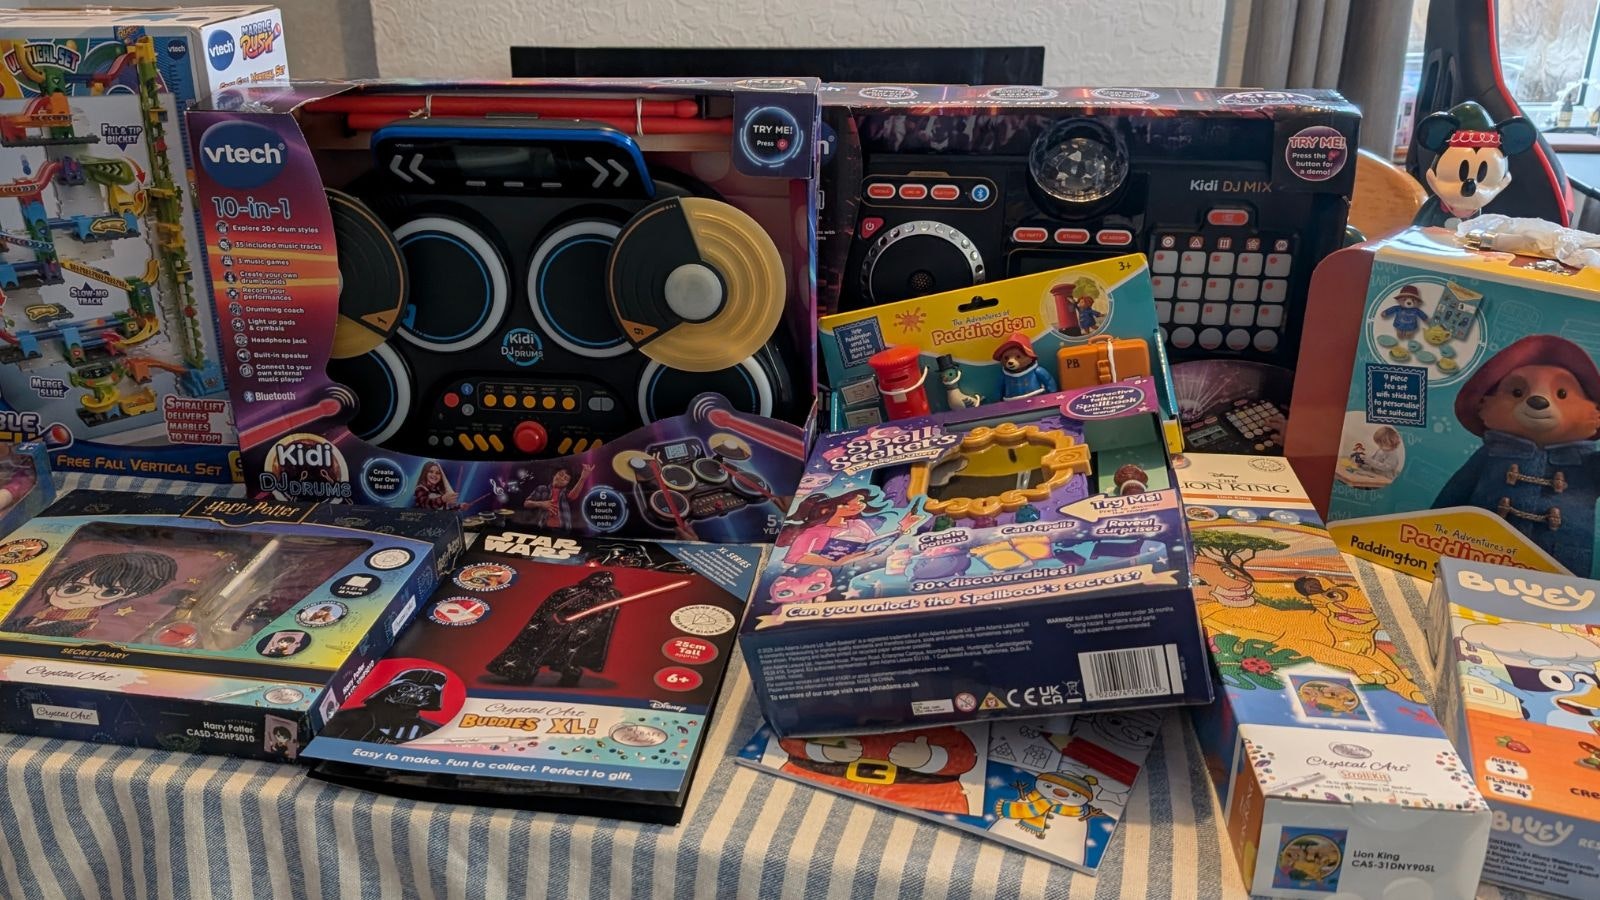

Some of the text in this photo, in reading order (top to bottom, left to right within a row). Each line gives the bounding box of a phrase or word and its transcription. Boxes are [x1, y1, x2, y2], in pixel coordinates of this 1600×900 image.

[241, 19, 272, 36] MARBLE
[209, 40, 235, 57] vtech
[240, 32, 273, 60] RUSH
[753, 125, 793, 134] TRY ME!
[107, 135, 138, 144] BUCKET
[1288, 136, 1346, 149] TRY ME!
[204, 143, 282, 164] vtech
[1295, 160, 1321, 168] button
[1190, 179, 1272, 193] Kidi DJ MIX
[211, 196, 291, 219] 10-in-1
[232, 224, 260, 232] Explore
[277, 225, 297, 233] drum
[298, 226, 319, 234] styles
[1118, 261, 1132, 271] 3+
[70, 288, 108, 298] SLOW-MO
[243, 294, 292, 302] performances
[78, 297, 103, 306] TRACK
[245, 306, 282, 314] Drumming
[248, 318, 267, 326] Light
[932, 316, 1036, 345] Paddington
[251, 337, 291, 345] Headphone
[509, 333, 534, 344] Kidi
[501, 346, 544, 358] DJ DRUMS
[31, 377, 64, 389] MERGE
[40, 388, 64, 397] SLIDE
[255, 391, 296, 401] Bluetooth
[1081, 388, 1134, 400] Interactive
[1391, 392, 1417, 400] stickers
[166, 397, 224, 412] SPIRAL LIFT
[1382, 400, 1420, 410] personalise
[167, 411, 208, 421] DELIVERS
[169, 422, 210, 432] MARBLES
[171, 432, 222, 443] TO THE TOP!
[847, 426, 933, 454] Spell
[277, 444, 332, 467] Kidi
[830, 434, 957, 471] Seekers
[57, 455, 223, 476] FREE FALL VERTICAL SET
[373, 468, 394, 476] Create
[259, 472, 352, 498] DJ DRUMS
[383, 476, 400, 484] Own
[1181, 481, 1290, 494] ION KING
[599, 491, 607, 500] 6
[1092, 492, 1162, 509] Try Me!
[204, 500, 300, 518] Harry Potter
[597, 520, 612, 528] pads
[1001, 521, 1075, 535] Cast spells
[1108, 518, 1154, 528] Reveal
[920, 530, 965, 543] Create
[1097, 526, 1161, 535] surprises
[500, 531, 582, 549] STAR
[919, 535, 968, 550] potions
[1434, 523, 1517, 555] The Adventures of
[484, 536, 574, 560] WARS
[1350, 535, 1427, 571] Paddington
[914, 565, 1075, 592] 30+ discoverables!
[787, 570, 1142, 617] Can you unlock the Spellbook's secrets?
[1457, 570, 1596, 612] BLUEY
[675, 640, 707, 651] 25cm
[60, 647, 130, 660] SECRET DIARY
[679, 647, 701, 657] Tall
[26, 665, 115, 682] Crystal Art
[666, 673, 689, 684] 6+
[854, 681, 920, 693] www.johnadams.co.uk
[1039, 684, 1060, 696] UK
[1007, 688, 1038, 708] CE
[1040, 695, 1064, 706] CA
[485, 702, 590, 717] Crystal Art
[649, 700, 687, 712] Disney
[36, 706, 92, 721] Crystal Art
[203, 721, 254, 734] Harry Potter
[458, 713, 540, 733] BUDDIES
[546, 717, 599, 737] XL!
[352, 748, 633, 783] Easy to make. Fun to collect. Perfect to gift.
[1306, 756, 1409, 772] Crystal Art
[1491, 757, 1518, 767] AGES
[1496, 764, 1518, 774] 3+
[1485, 775, 1532, 790] PLAYERS
[1492, 810, 1574, 846] BLUEY
[1353, 850, 1400, 862] Lion King
